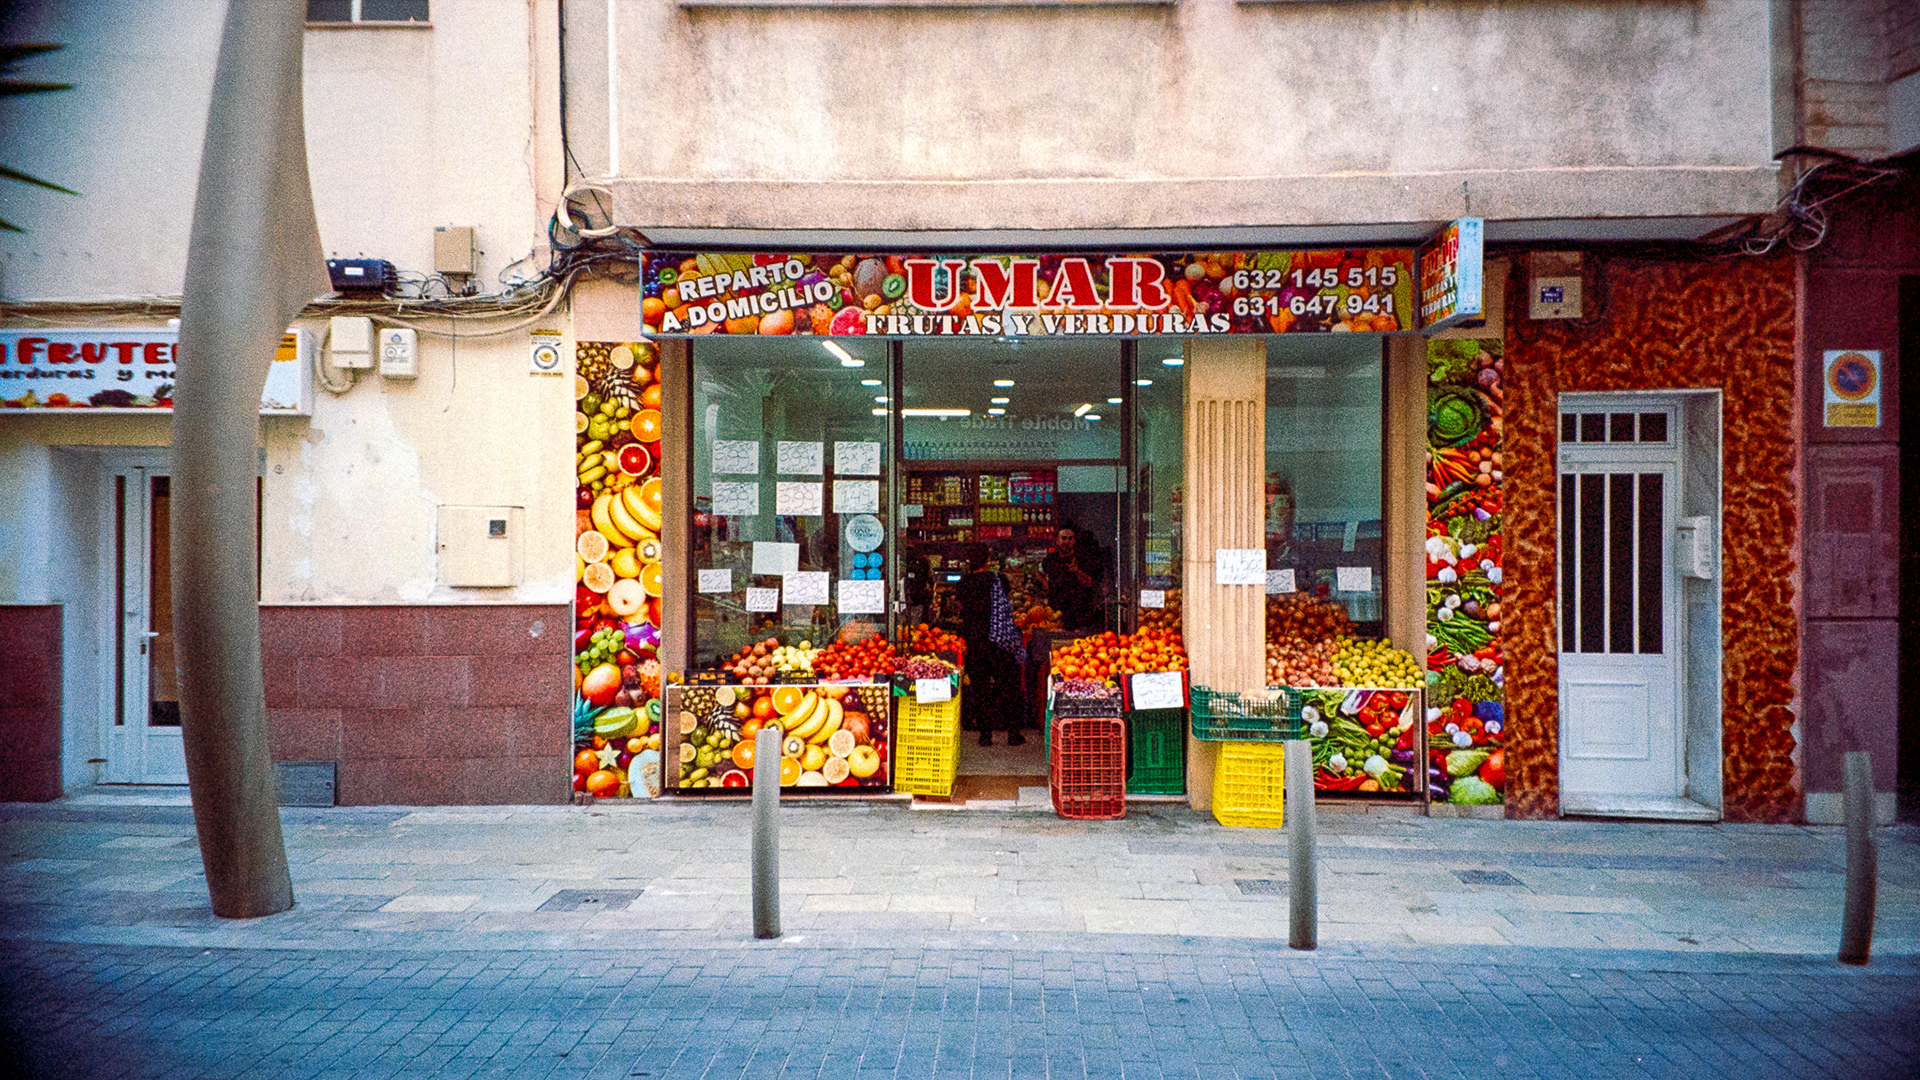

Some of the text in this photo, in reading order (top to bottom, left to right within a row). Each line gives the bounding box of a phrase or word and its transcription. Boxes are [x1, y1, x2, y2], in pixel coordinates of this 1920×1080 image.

[679, 259, 804, 301] REPARTO
[904, 259, 1171, 311] UMAR
[1233, 267, 1396, 289] 632 145 515
[662, 281, 834, 332] A DOMICILIO
[1233, 294, 1393, 316] 631 647 941
[865, 313, 1231, 335] FRUTAS Y VERDURAS
[117, 370, 134, 382] y
